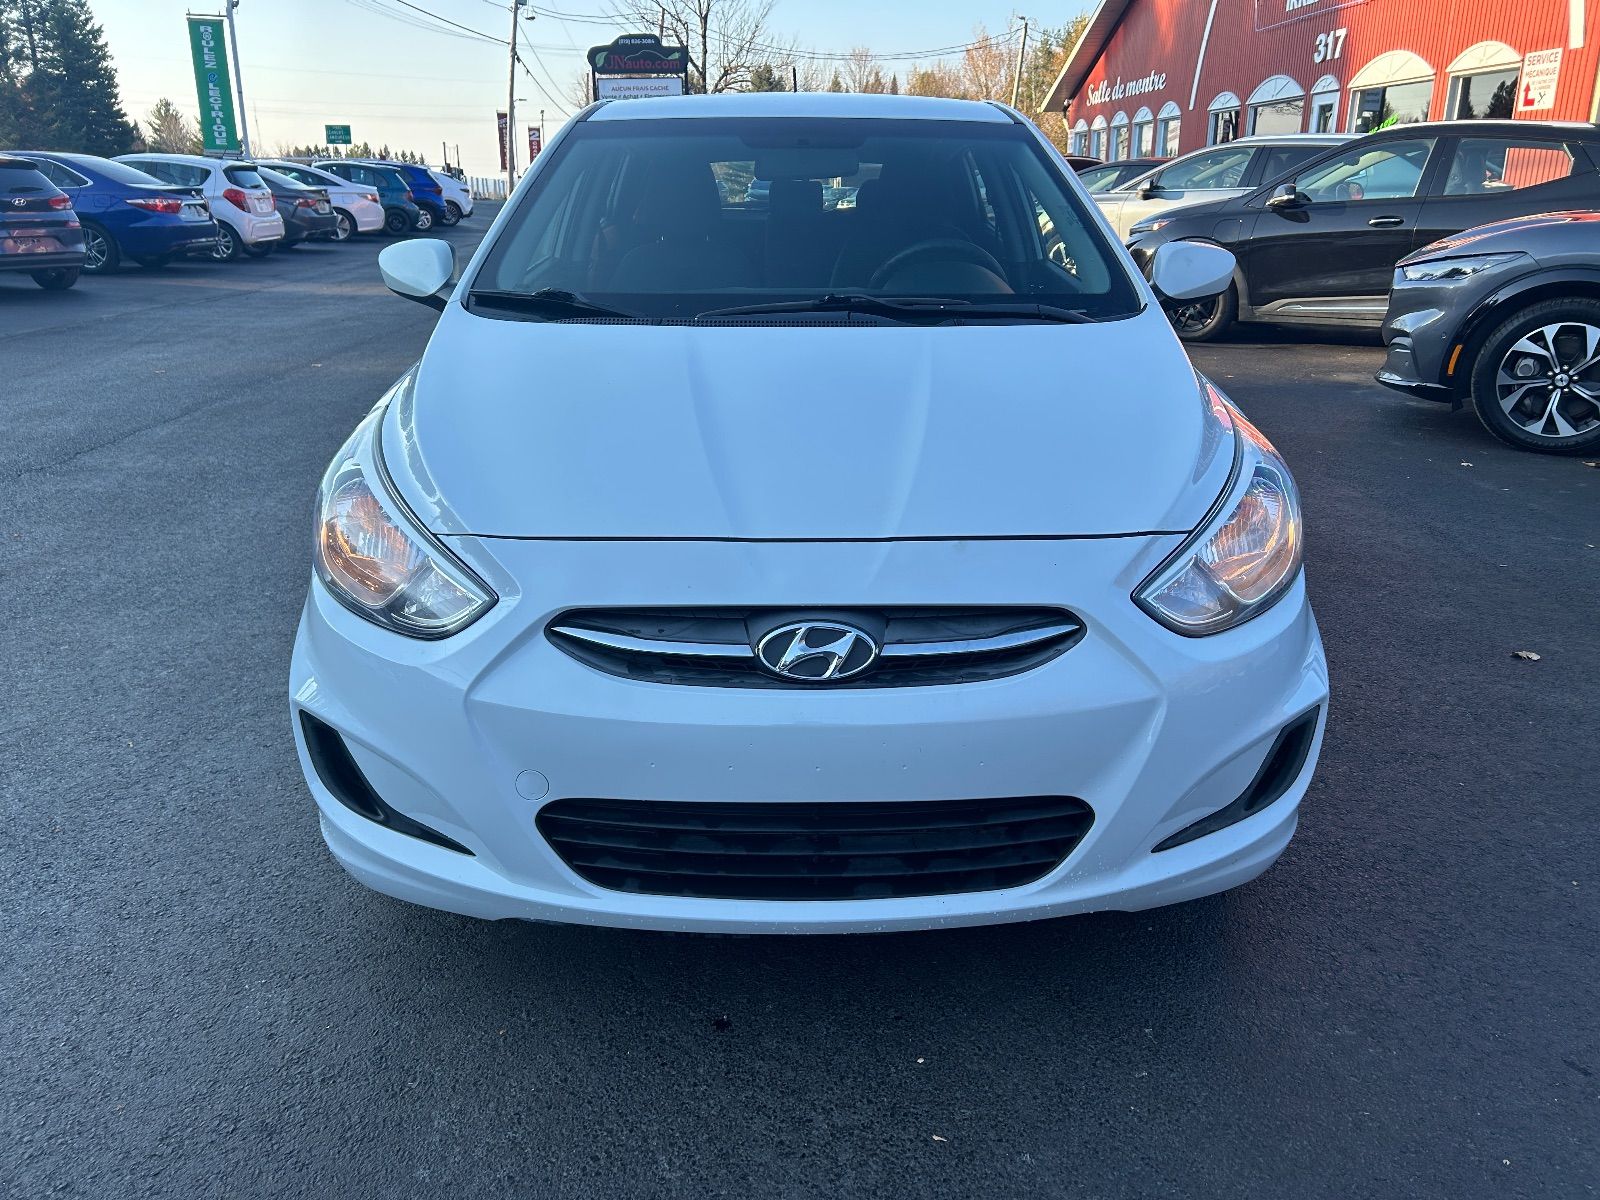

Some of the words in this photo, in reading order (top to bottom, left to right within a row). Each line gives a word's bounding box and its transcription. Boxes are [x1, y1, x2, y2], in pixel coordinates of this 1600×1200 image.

[1314, 27, 1348, 64] 317
[605, 55, 680, 69] JNauto.com
[1527, 52, 1559, 66] SERVICE
[1086, 79, 1111, 107] Salle
[1111, 75, 1125, 101] de
[1125, 69, 1167, 97] montre
